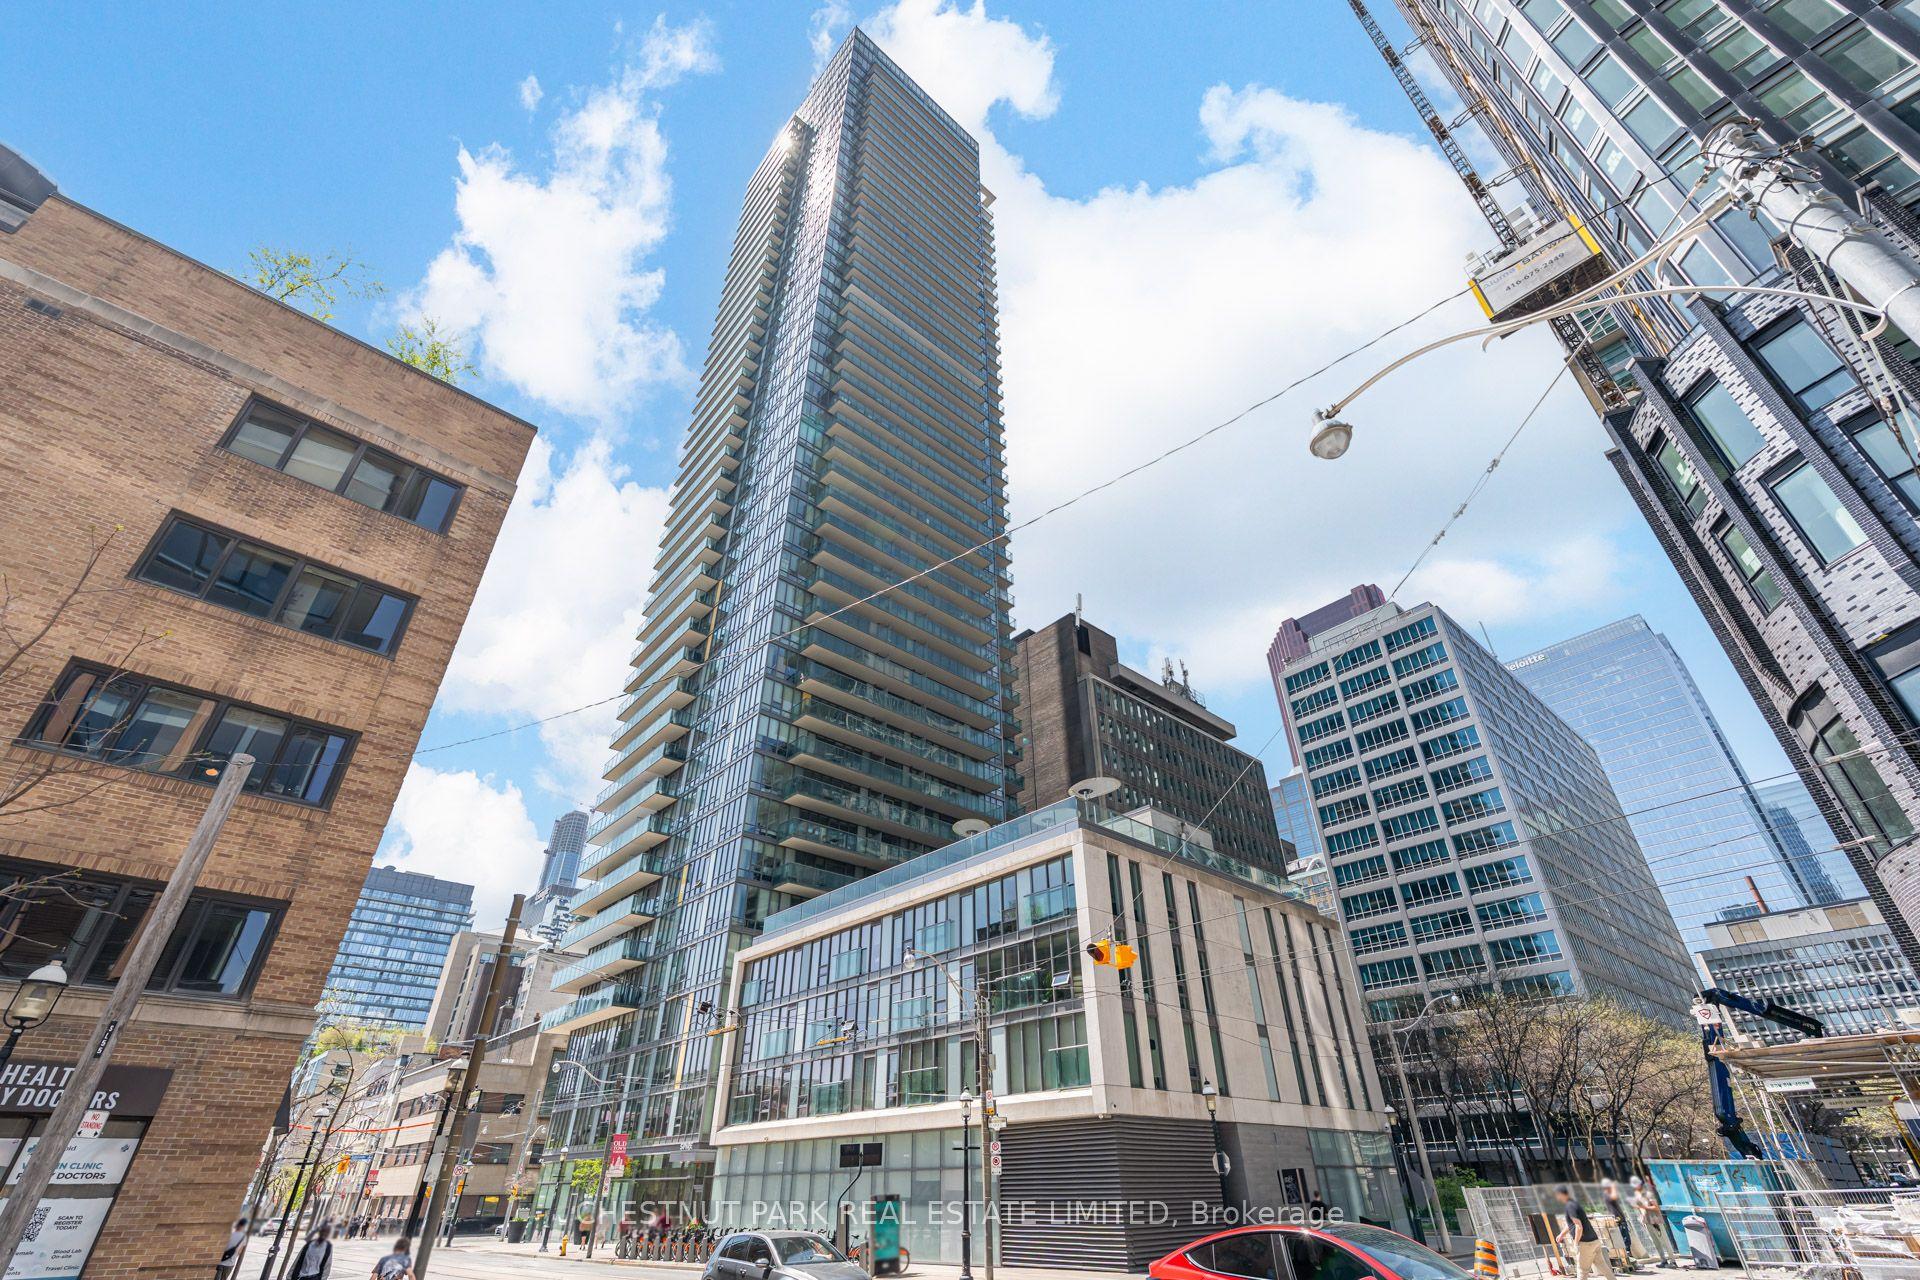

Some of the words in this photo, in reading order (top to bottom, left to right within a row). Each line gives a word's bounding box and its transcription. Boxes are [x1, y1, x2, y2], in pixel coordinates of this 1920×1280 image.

[1505, 252, 1565, 292] 416-675-2449
[0, 1064, 76, 1087] HEALT
[17, 1087, 120, 1110] DOCRS
[91, 1113, 100, 1121] NO
[80, 1121, 103, 1130] STANDING
[69, 1162, 104, 1170] CLINIC
[56, 1172, 107, 1180] DOCTORS
